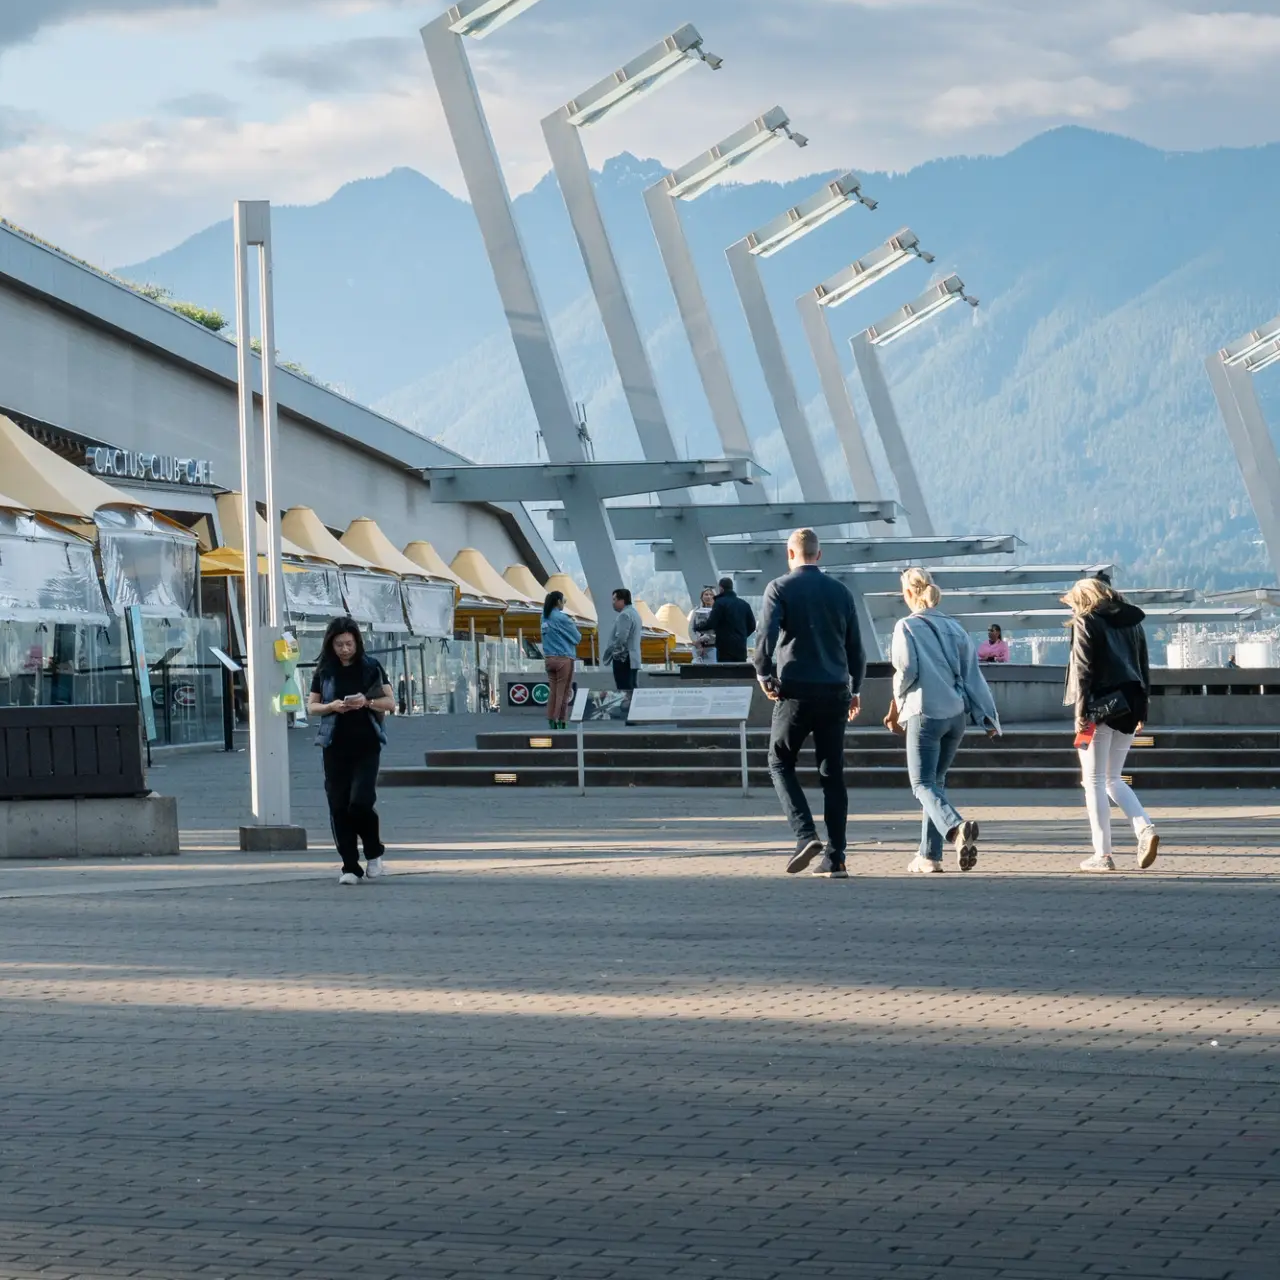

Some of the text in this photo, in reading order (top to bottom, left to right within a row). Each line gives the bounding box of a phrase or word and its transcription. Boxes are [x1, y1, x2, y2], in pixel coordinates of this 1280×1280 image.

[93, 446, 214, 485] CACTUS CLUB CAFE
